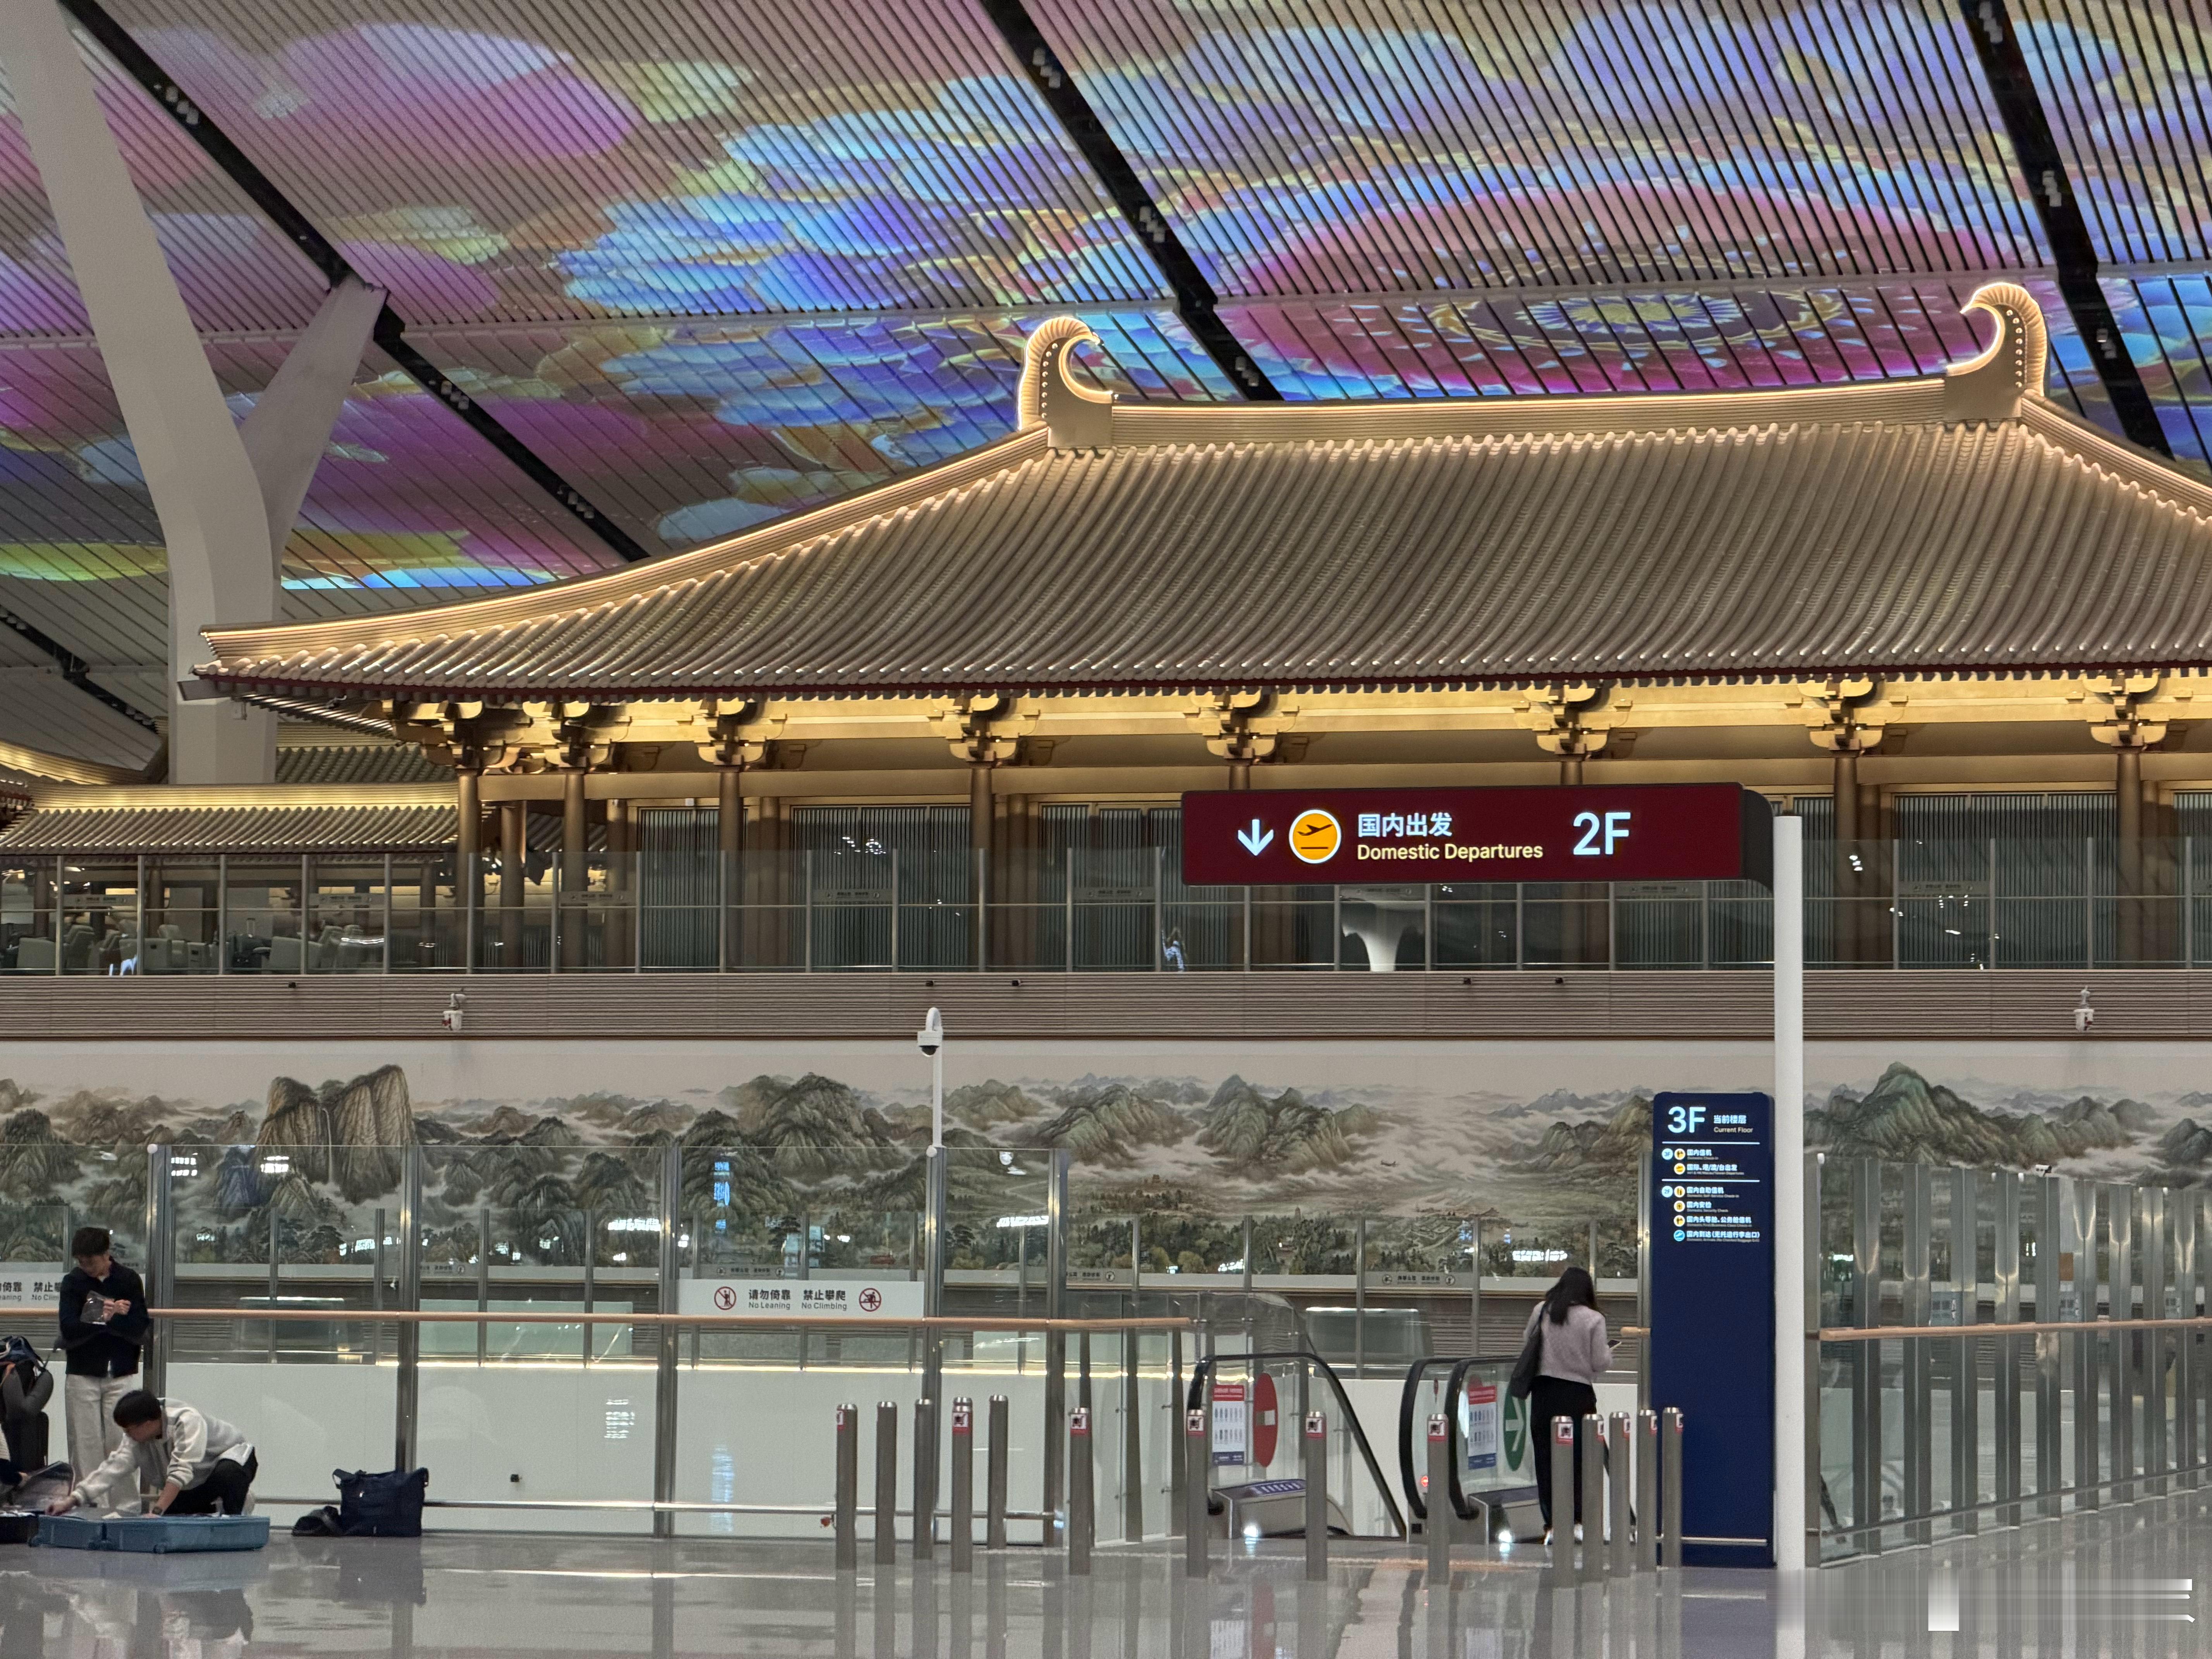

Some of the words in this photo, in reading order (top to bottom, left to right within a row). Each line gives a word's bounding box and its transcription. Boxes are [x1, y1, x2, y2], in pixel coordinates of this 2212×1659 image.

[1358, 812, 1452, 837] 国内出发
[1573, 812, 1631, 855] 2F
[1358, 843, 1440, 860] Domestic
[1445, 843, 1543, 862] Departures
[1668, 1106, 1706, 1133] 3F
[1714, 1115, 1747, 1124] 当前楼层
[749, 1289, 791, 1300] 请勿倚靠
[803, 1290, 846, 1301] 禁止攀爬
[761, 1302, 791, 1310] Leaning
[814, 1303, 847, 1311] Climbing
